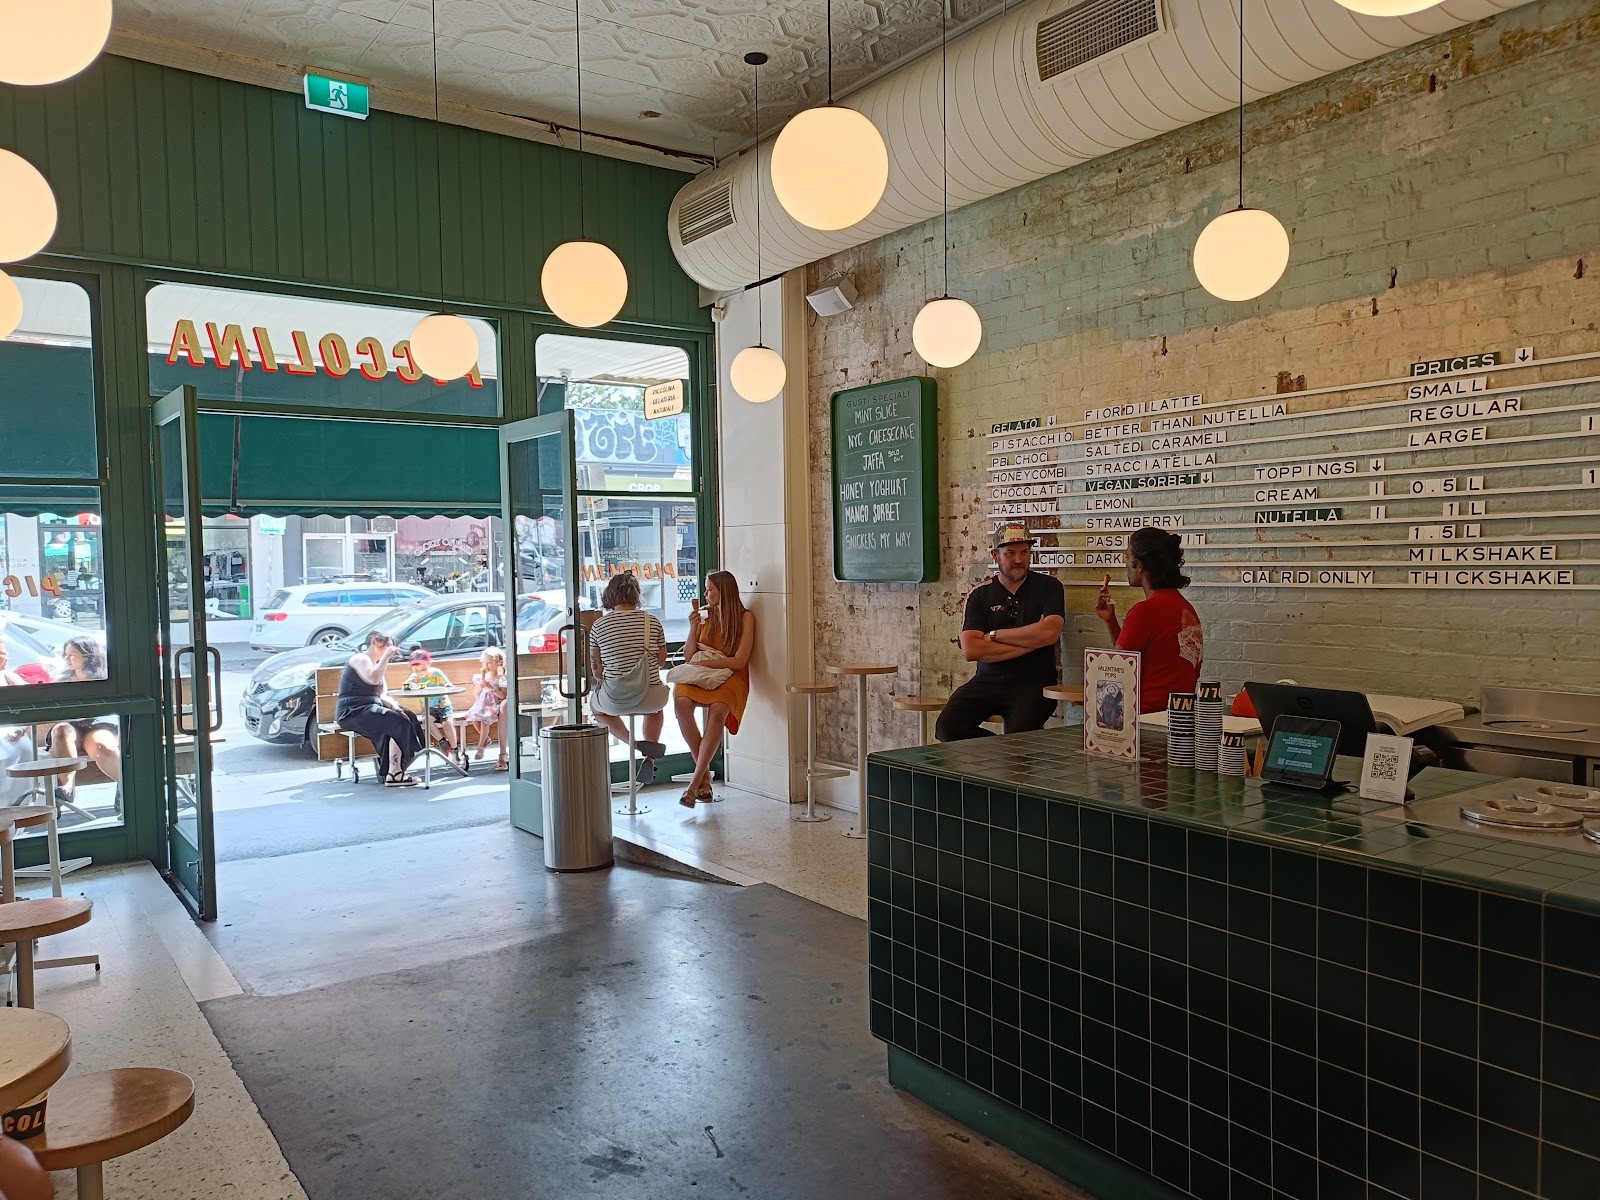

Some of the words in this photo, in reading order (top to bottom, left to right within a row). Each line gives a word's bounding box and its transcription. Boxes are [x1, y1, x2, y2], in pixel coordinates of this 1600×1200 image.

[1413, 355, 1496, 376] PRICES
[652, 384, 675, 396] PICCOLINA
[1409, 378, 1483, 400] SMALL
[652, 394, 676, 405] GELATERIA
[846, 397, 871, 408] GUSTI
[872, 390, 910, 404] SPECIALI
[854, 407, 873, 425] MINT
[875, 402, 898, 421] SLICE
[1409, 398, 1519, 422] REGULAR
[992, 418, 1039, 434] GELATO
[1085, 423, 1140, 440] BETTER
[1152, 416, 1193, 432] THAN
[1203, 404, 1285, 426] NUTELLA
[847, 432, 863, 450] NYC
[868, 422, 915, 446] CHEESECAKE
[991, 432, 1073, 452] PISTACCHIO
[1085, 441, 1140, 458] SALTED
[1151, 432, 1225, 451] CARAMEL
[1409, 427, 1484, 447] LARGE
[862, 451, 886, 471] JAFFA
[992, 456, 1008, 468] PB
[1015, 452, 1048, 467] CHOC
[1086, 453, 1214, 476] STRACCIATELLA
[992, 468, 1065, 483] HONEYCOMB
[1255, 461, 1356, 480] TOPPINGS
[839, 481, 865, 502] HONEY
[869, 477, 908, 498] YOGHURT
[1087, 478, 1133, 492] VEGAN
[1137, 473, 1198, 489] SORBET
[992, 486, 1065, 499] CHOCOLATE
[1255, 487, 1318, 502] CREAM
[845, 504, 869, 524] MANGO
[872, 501, 901, 524] SORBET
[992, 503, 1057, 515] HAZELNUT
[1086, 498, 1131, 511] LEMON
[1086, 514, 1183, 529] STRAWBERRY
[1256, 508, 1339, 523] NUTELLA
[845, 531, 877, 551] SNICKERS
[880, 531, 891, 549] MY
[895, 531, 911, 548] WAY
[1040, 553, 1075, 565] CHOC
[1086, 553, 1122, 564] DARK
[1409, 546, 1554, 562] MILKSHAKE
[1319, 570, 1372, 584] ONLY
[1410, 570, 1571, 585] THICKSHAKE
